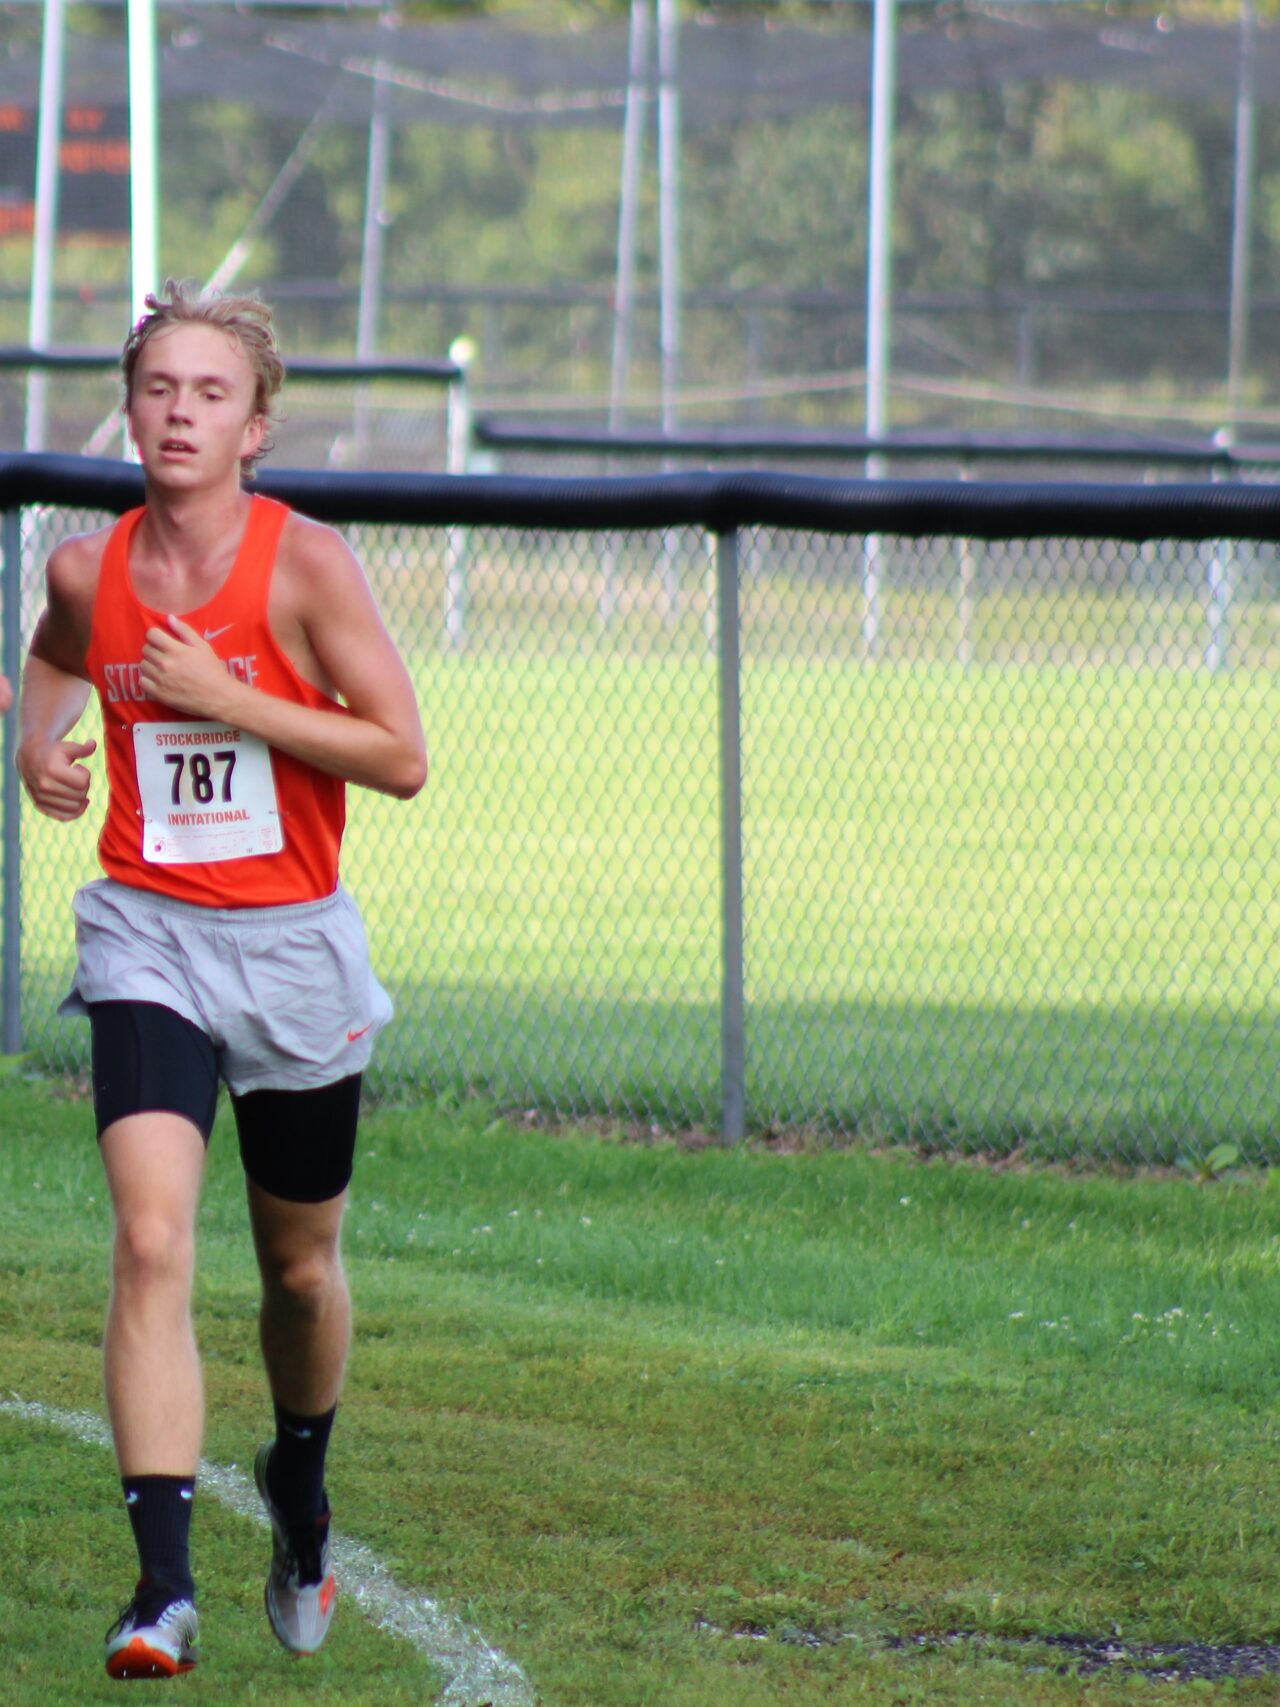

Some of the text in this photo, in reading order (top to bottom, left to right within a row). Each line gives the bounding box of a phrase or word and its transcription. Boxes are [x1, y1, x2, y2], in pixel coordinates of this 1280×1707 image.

[156, 730, 242, 746] STOCKBRIDGE
[164, 750, 237, 806] 787
[167, 809, 250, 826] INVITATIONAL
